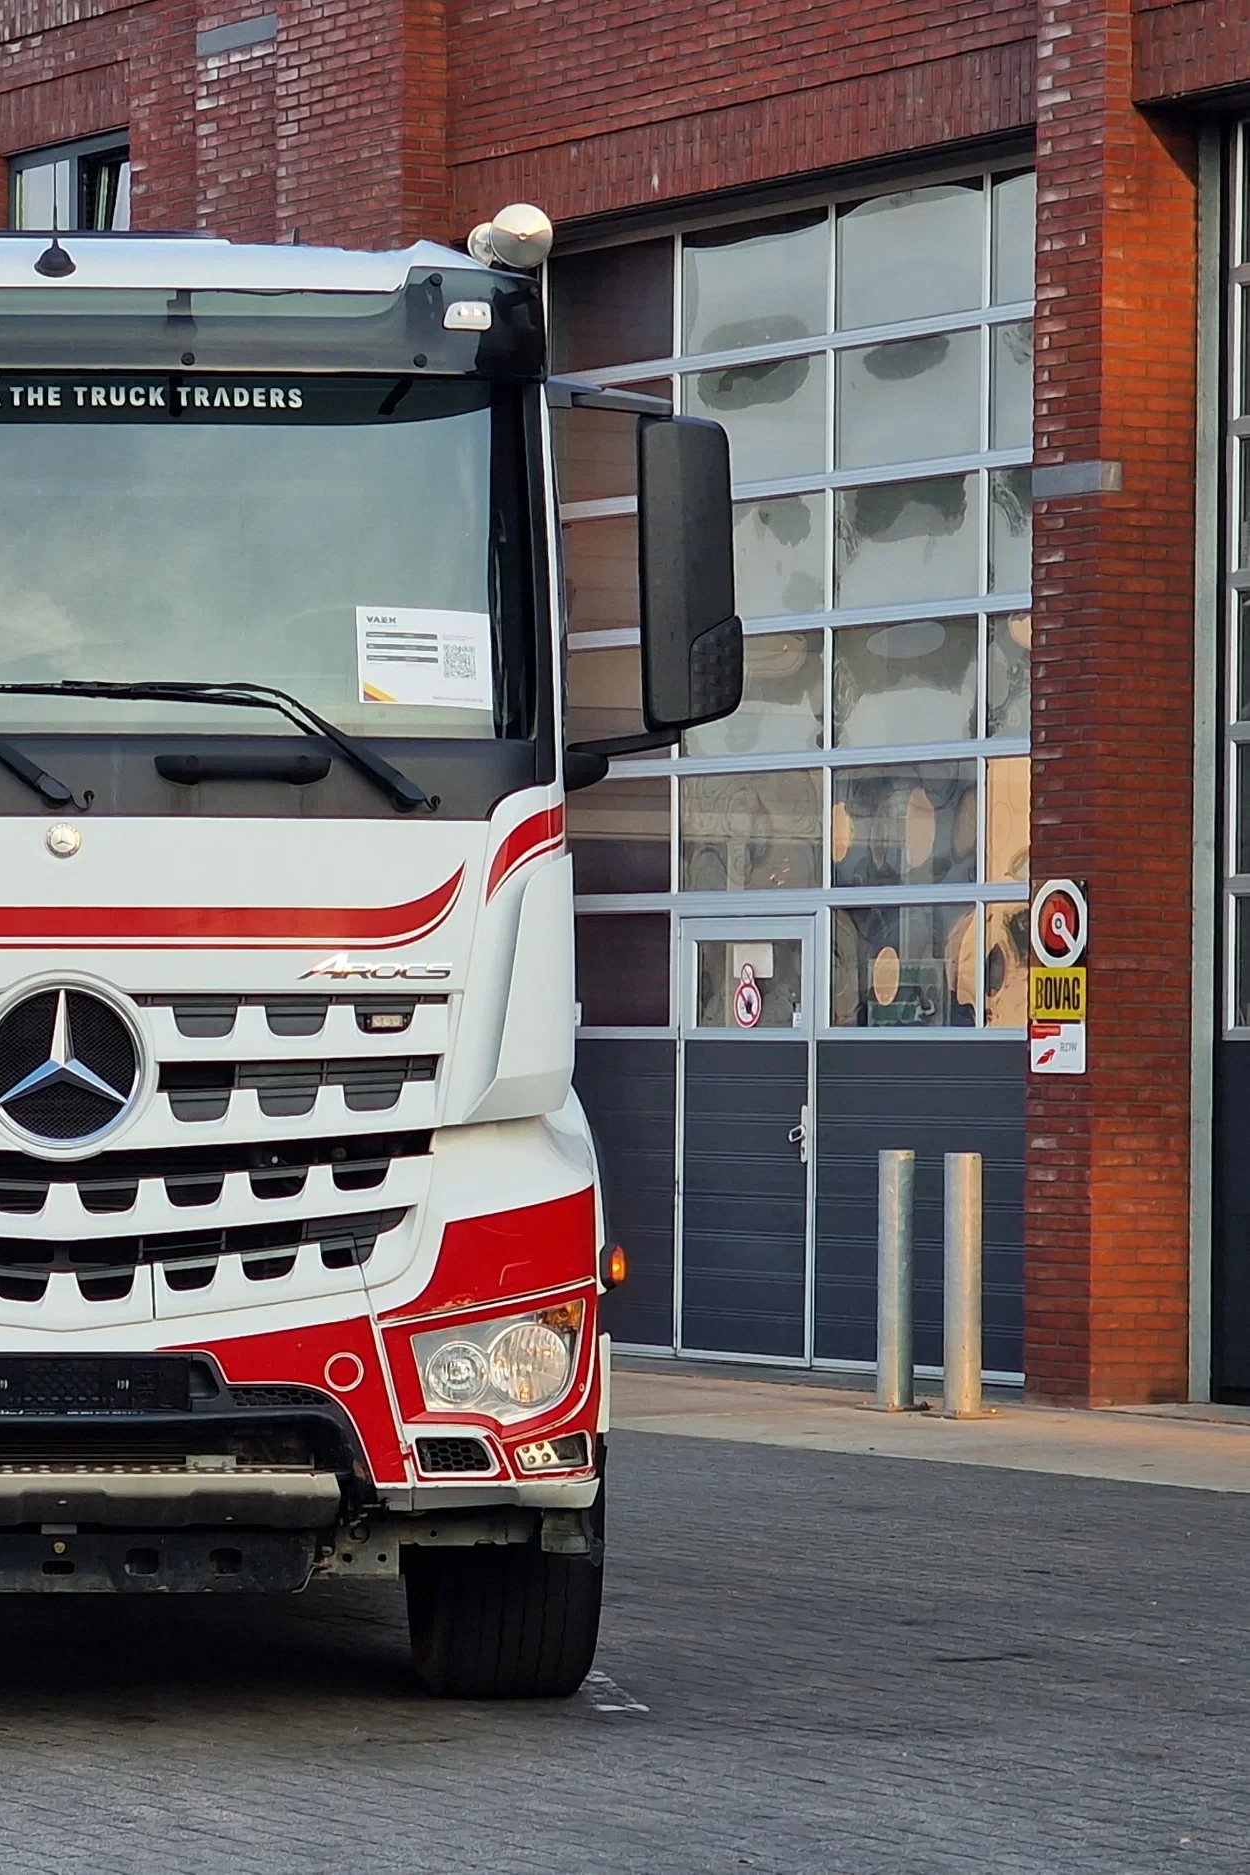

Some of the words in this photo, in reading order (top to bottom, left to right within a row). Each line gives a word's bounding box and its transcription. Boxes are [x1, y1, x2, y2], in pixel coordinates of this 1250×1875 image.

[9, 386, 61, 406] THE
[73, 386, 166, 407] TRUCK
[177, 386, 303, 408] TRADERS
[366, 616, 397, 624] VAEX
[296, 952, 453, 980] AROCS
[1035, 976, 1081, 1011] BOVAG
[1059, 1042, 1078, 1052] RDW
